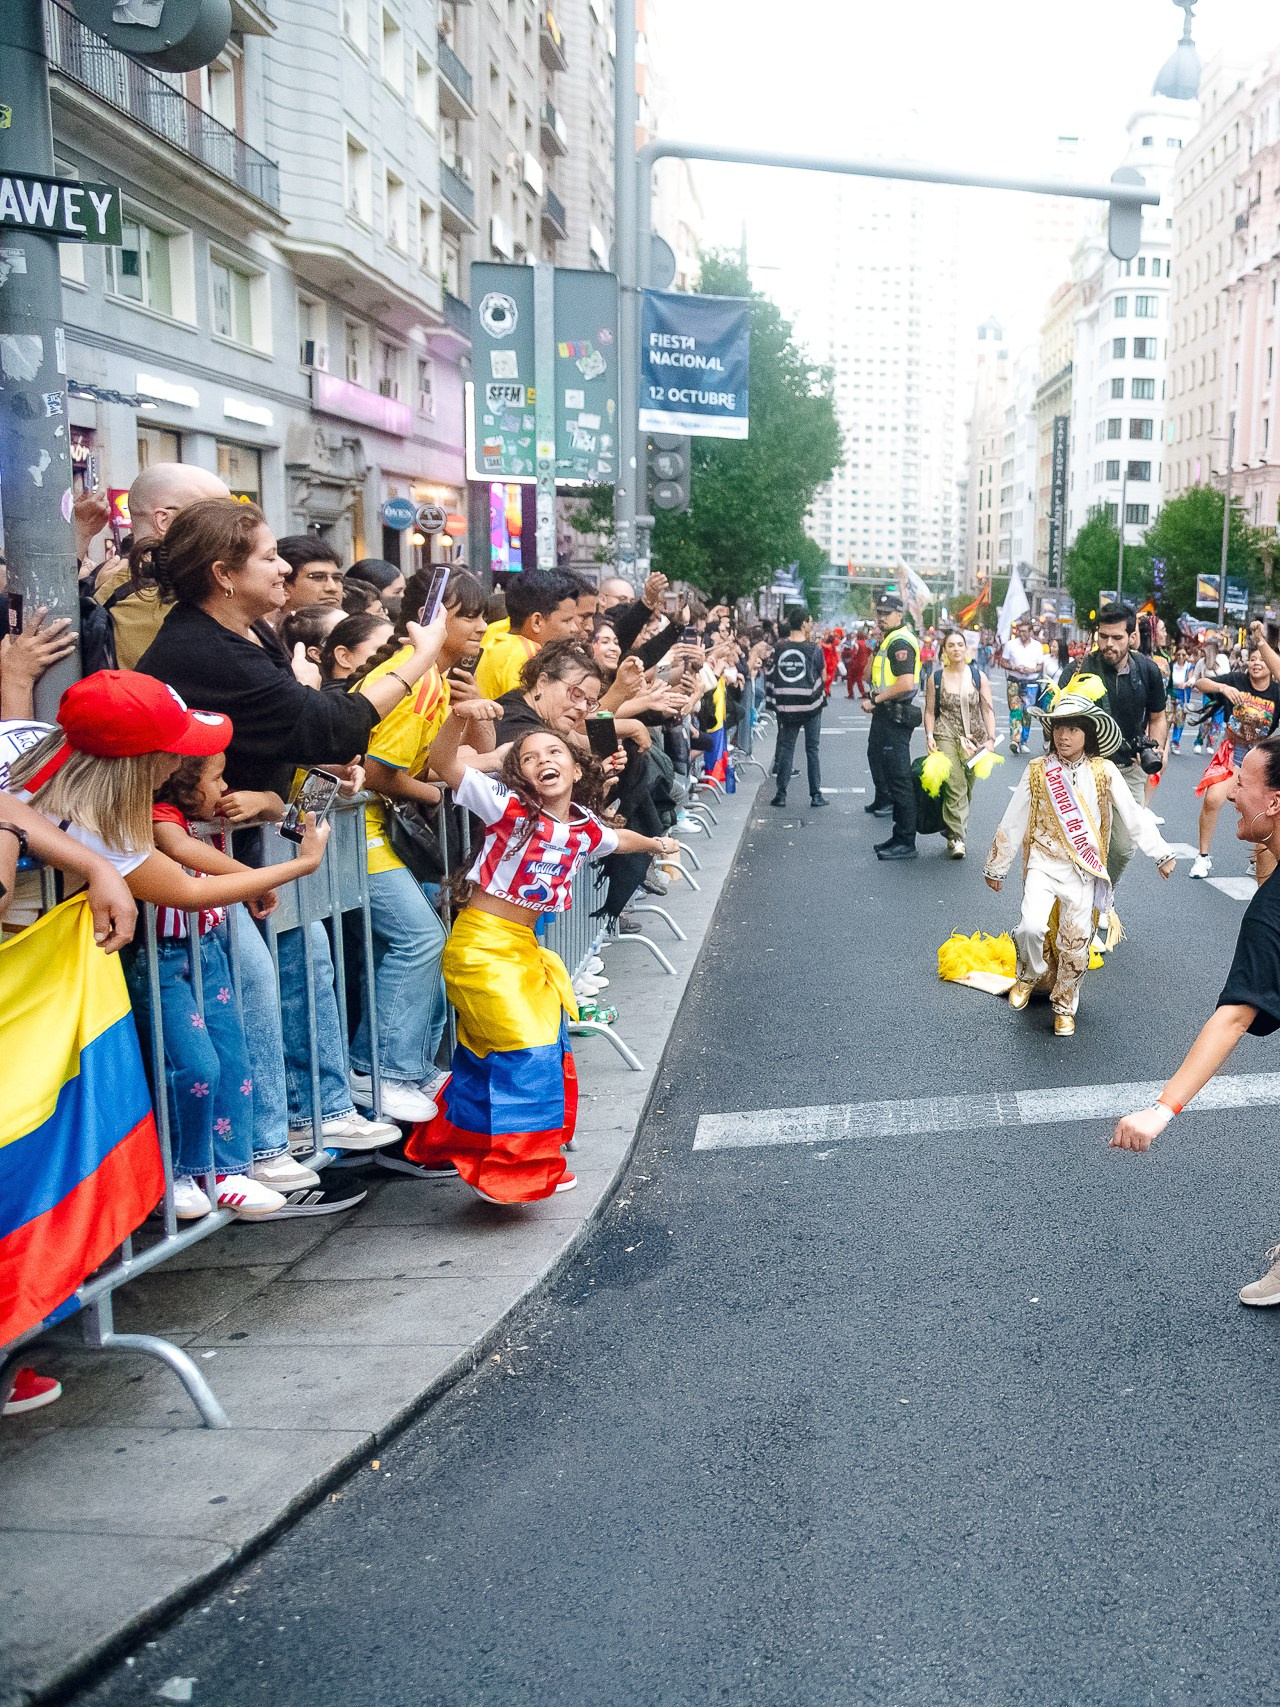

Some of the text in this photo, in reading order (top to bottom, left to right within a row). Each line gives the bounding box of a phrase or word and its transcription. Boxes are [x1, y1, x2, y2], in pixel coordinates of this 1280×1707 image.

[650, 332, 696, 351] FIESTA
[650, 350, 725, 371] NACIONAL
[649, 386, 736, 411] 12 OCTUBRE
[1045, 766, 1078, 815] Carnaval
[1065, 818, 1083, 833] de
[1071, 831, 1089, 851] los
[527, 862, 563, 876] AGUILA
[494, 889, 562, 913] OLIMPICA
